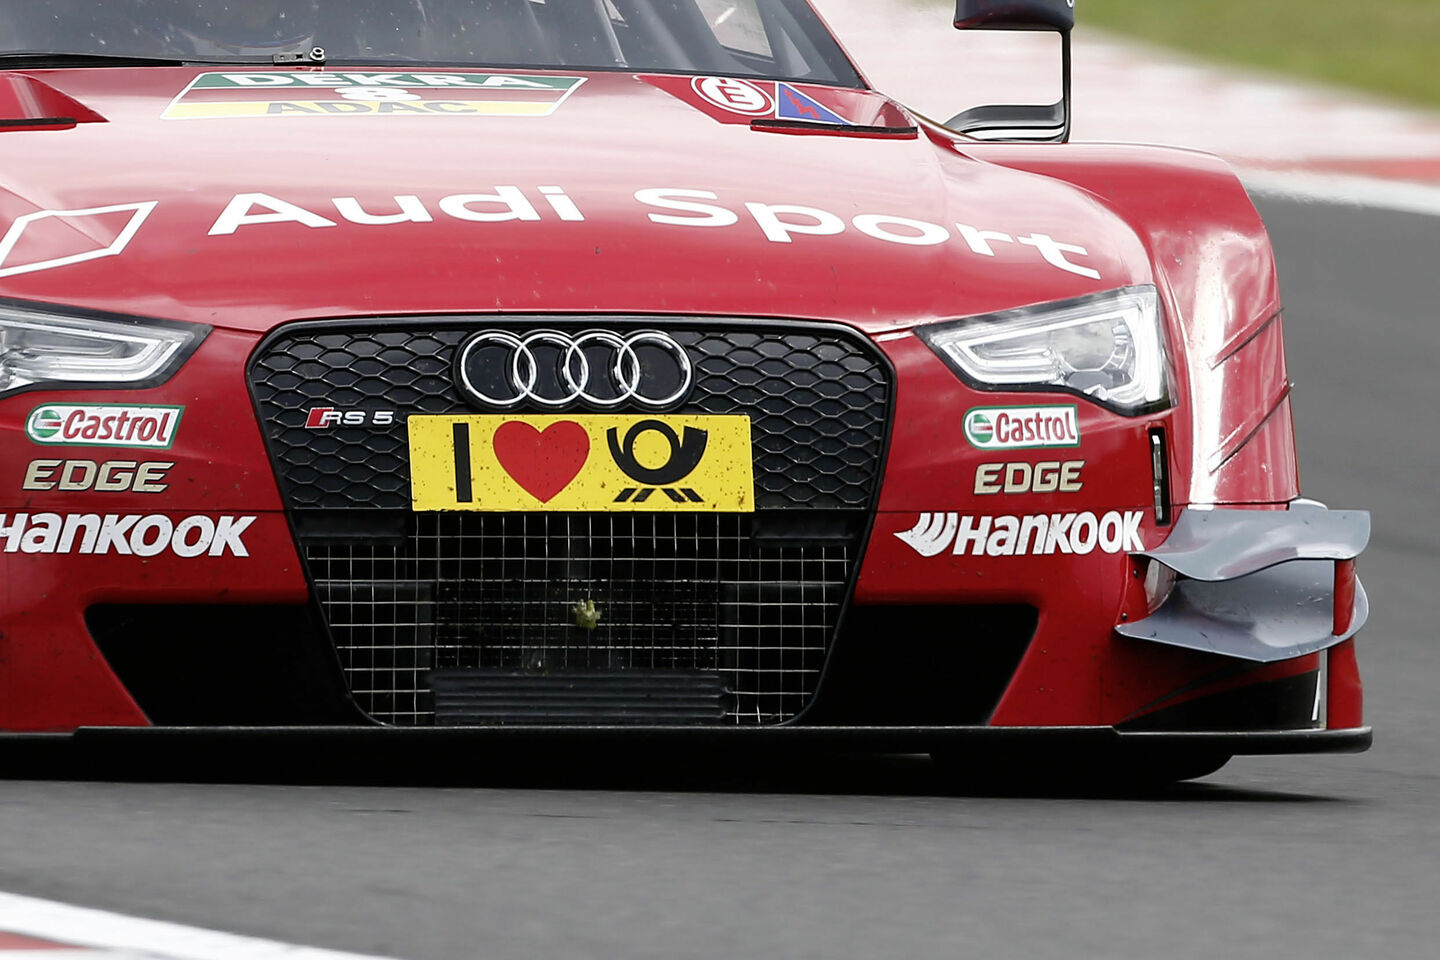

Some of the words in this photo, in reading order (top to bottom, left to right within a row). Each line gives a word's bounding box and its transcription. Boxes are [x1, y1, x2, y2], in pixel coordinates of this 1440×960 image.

[222, 73, 554, 88] DEKRA
[334, 86, 421, 101] 8
[266, 101, 479, 115] ADAC
[206, 185, 586, 235] Audi
[632, 187, 1102, 281] Sport
[63, 409, 171, 442] Castrol
[318, 410, 366, 426] RS
[372, 410, 394, 426] 5
[995, 411, 1076, 443] Castrol
[22, 458, 176, 493] EDGE
[973, 460, 1086, 495] EDGE
